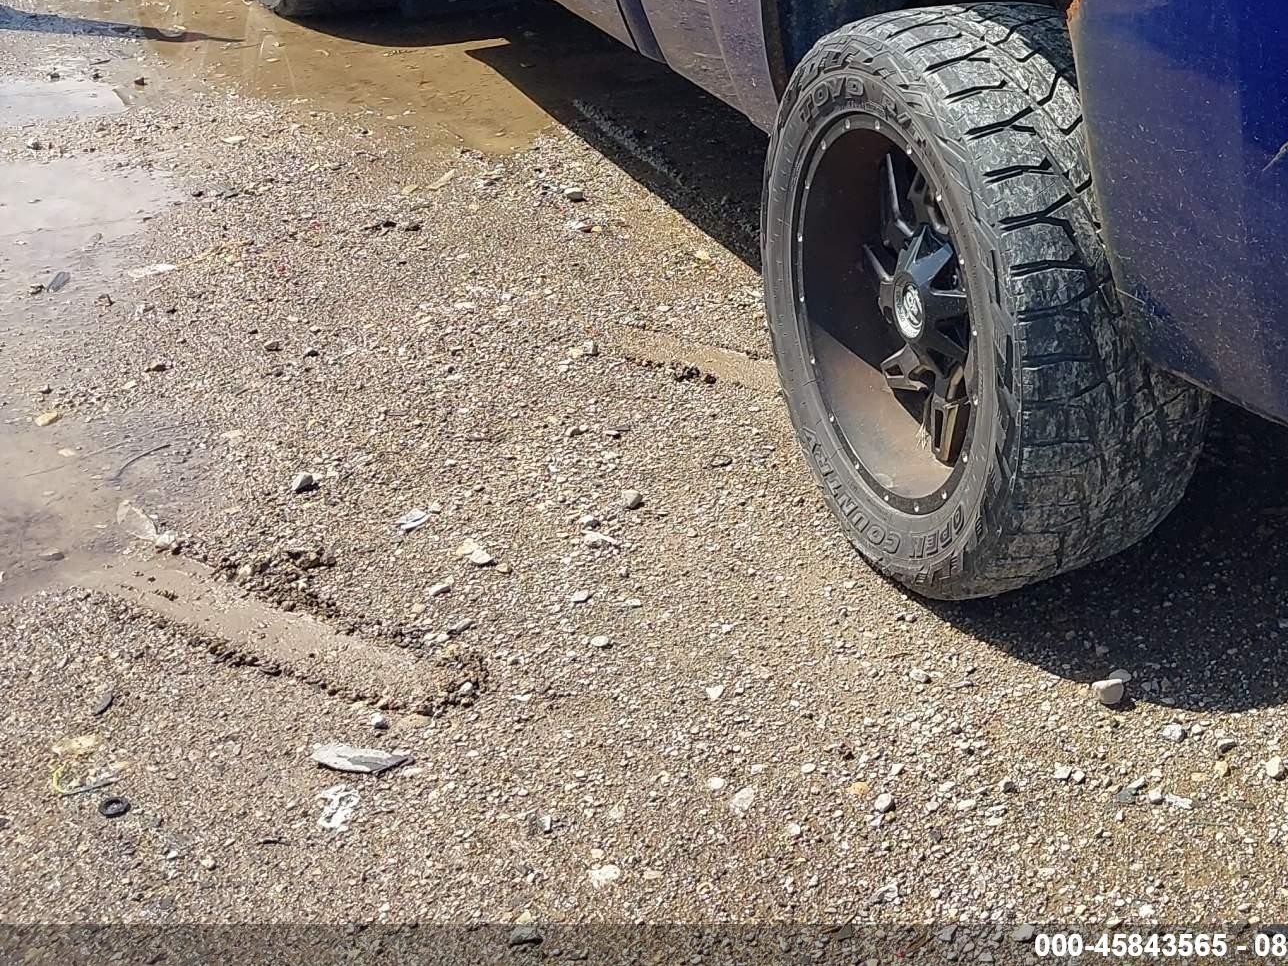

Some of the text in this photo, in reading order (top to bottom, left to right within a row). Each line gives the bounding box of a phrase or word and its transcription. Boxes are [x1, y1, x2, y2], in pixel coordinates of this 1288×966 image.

[799, 76, 865, 122] TOYO
[802, 427, 964, 558] OPEN COUNTRY
